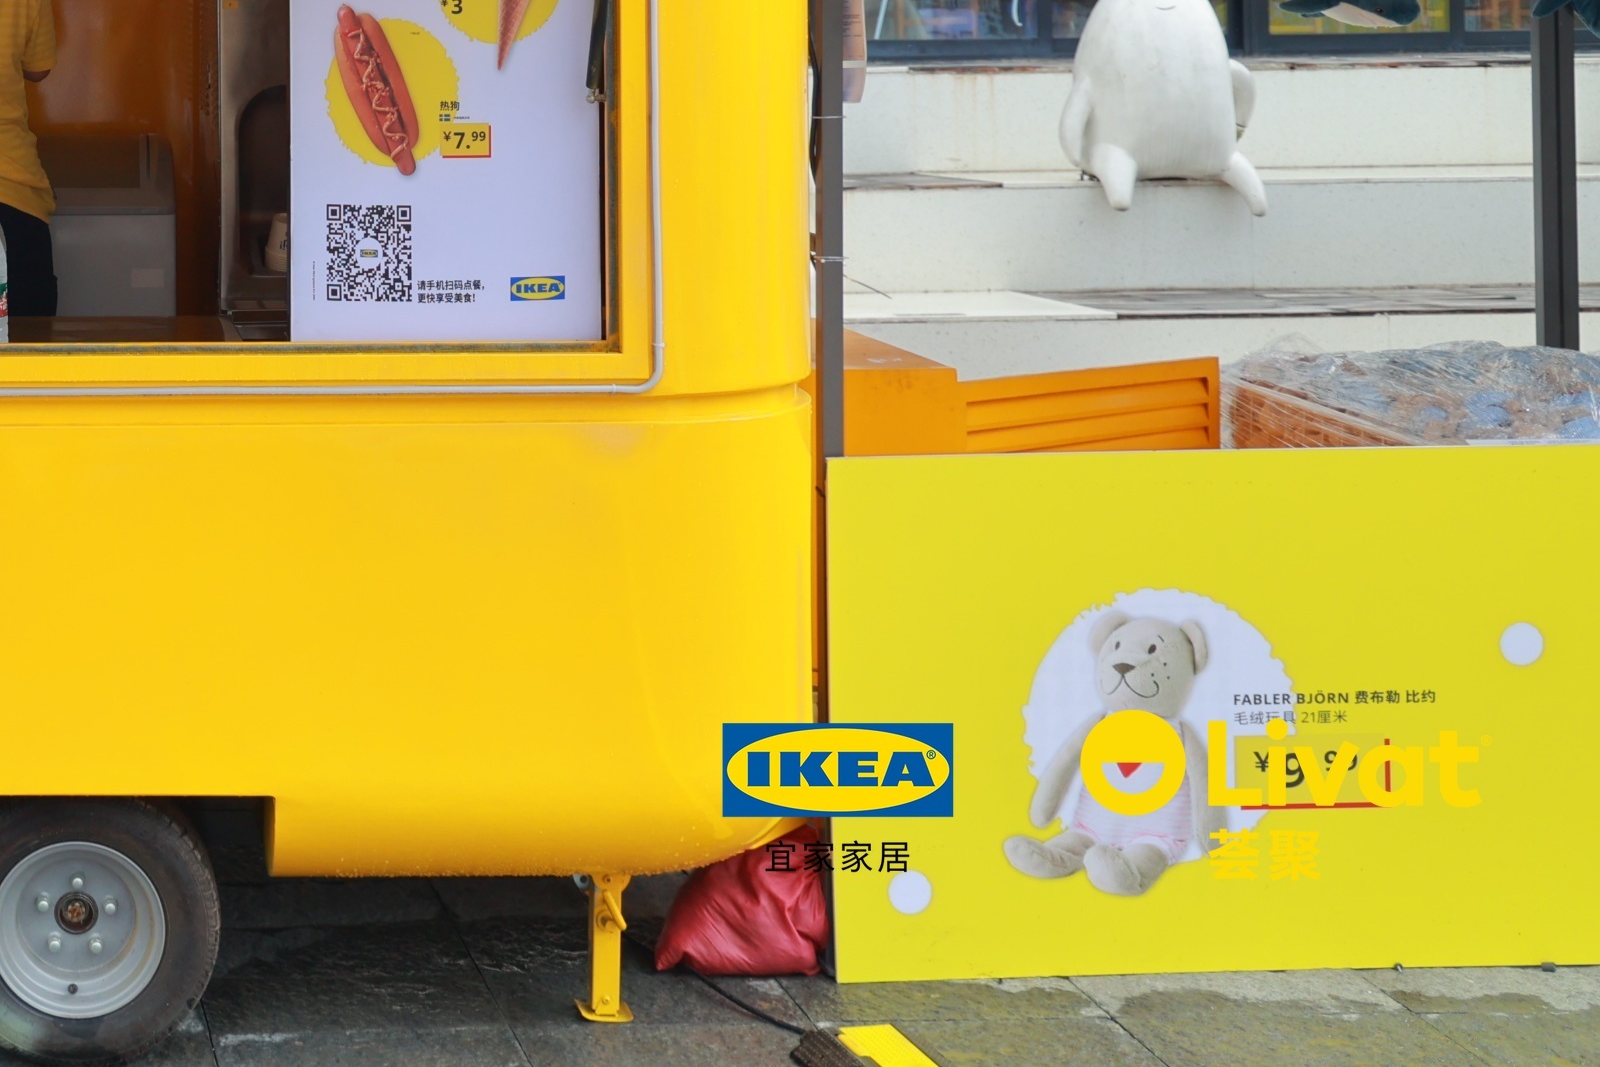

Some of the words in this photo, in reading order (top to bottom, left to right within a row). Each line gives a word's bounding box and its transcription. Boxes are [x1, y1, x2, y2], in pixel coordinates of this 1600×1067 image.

[440, 100, 460, 111] 热狗
[516, 283, 560, 293] IKEA
[1234, 694, 1291, 705] FABLER
[1297, 690, 1349, 704] BJÖRN
[1355, 690, 1400, 704] 费布勒
[1406, 689, 1436, 703] 比约
[1301, 710, 1348, 723] 21厘米
